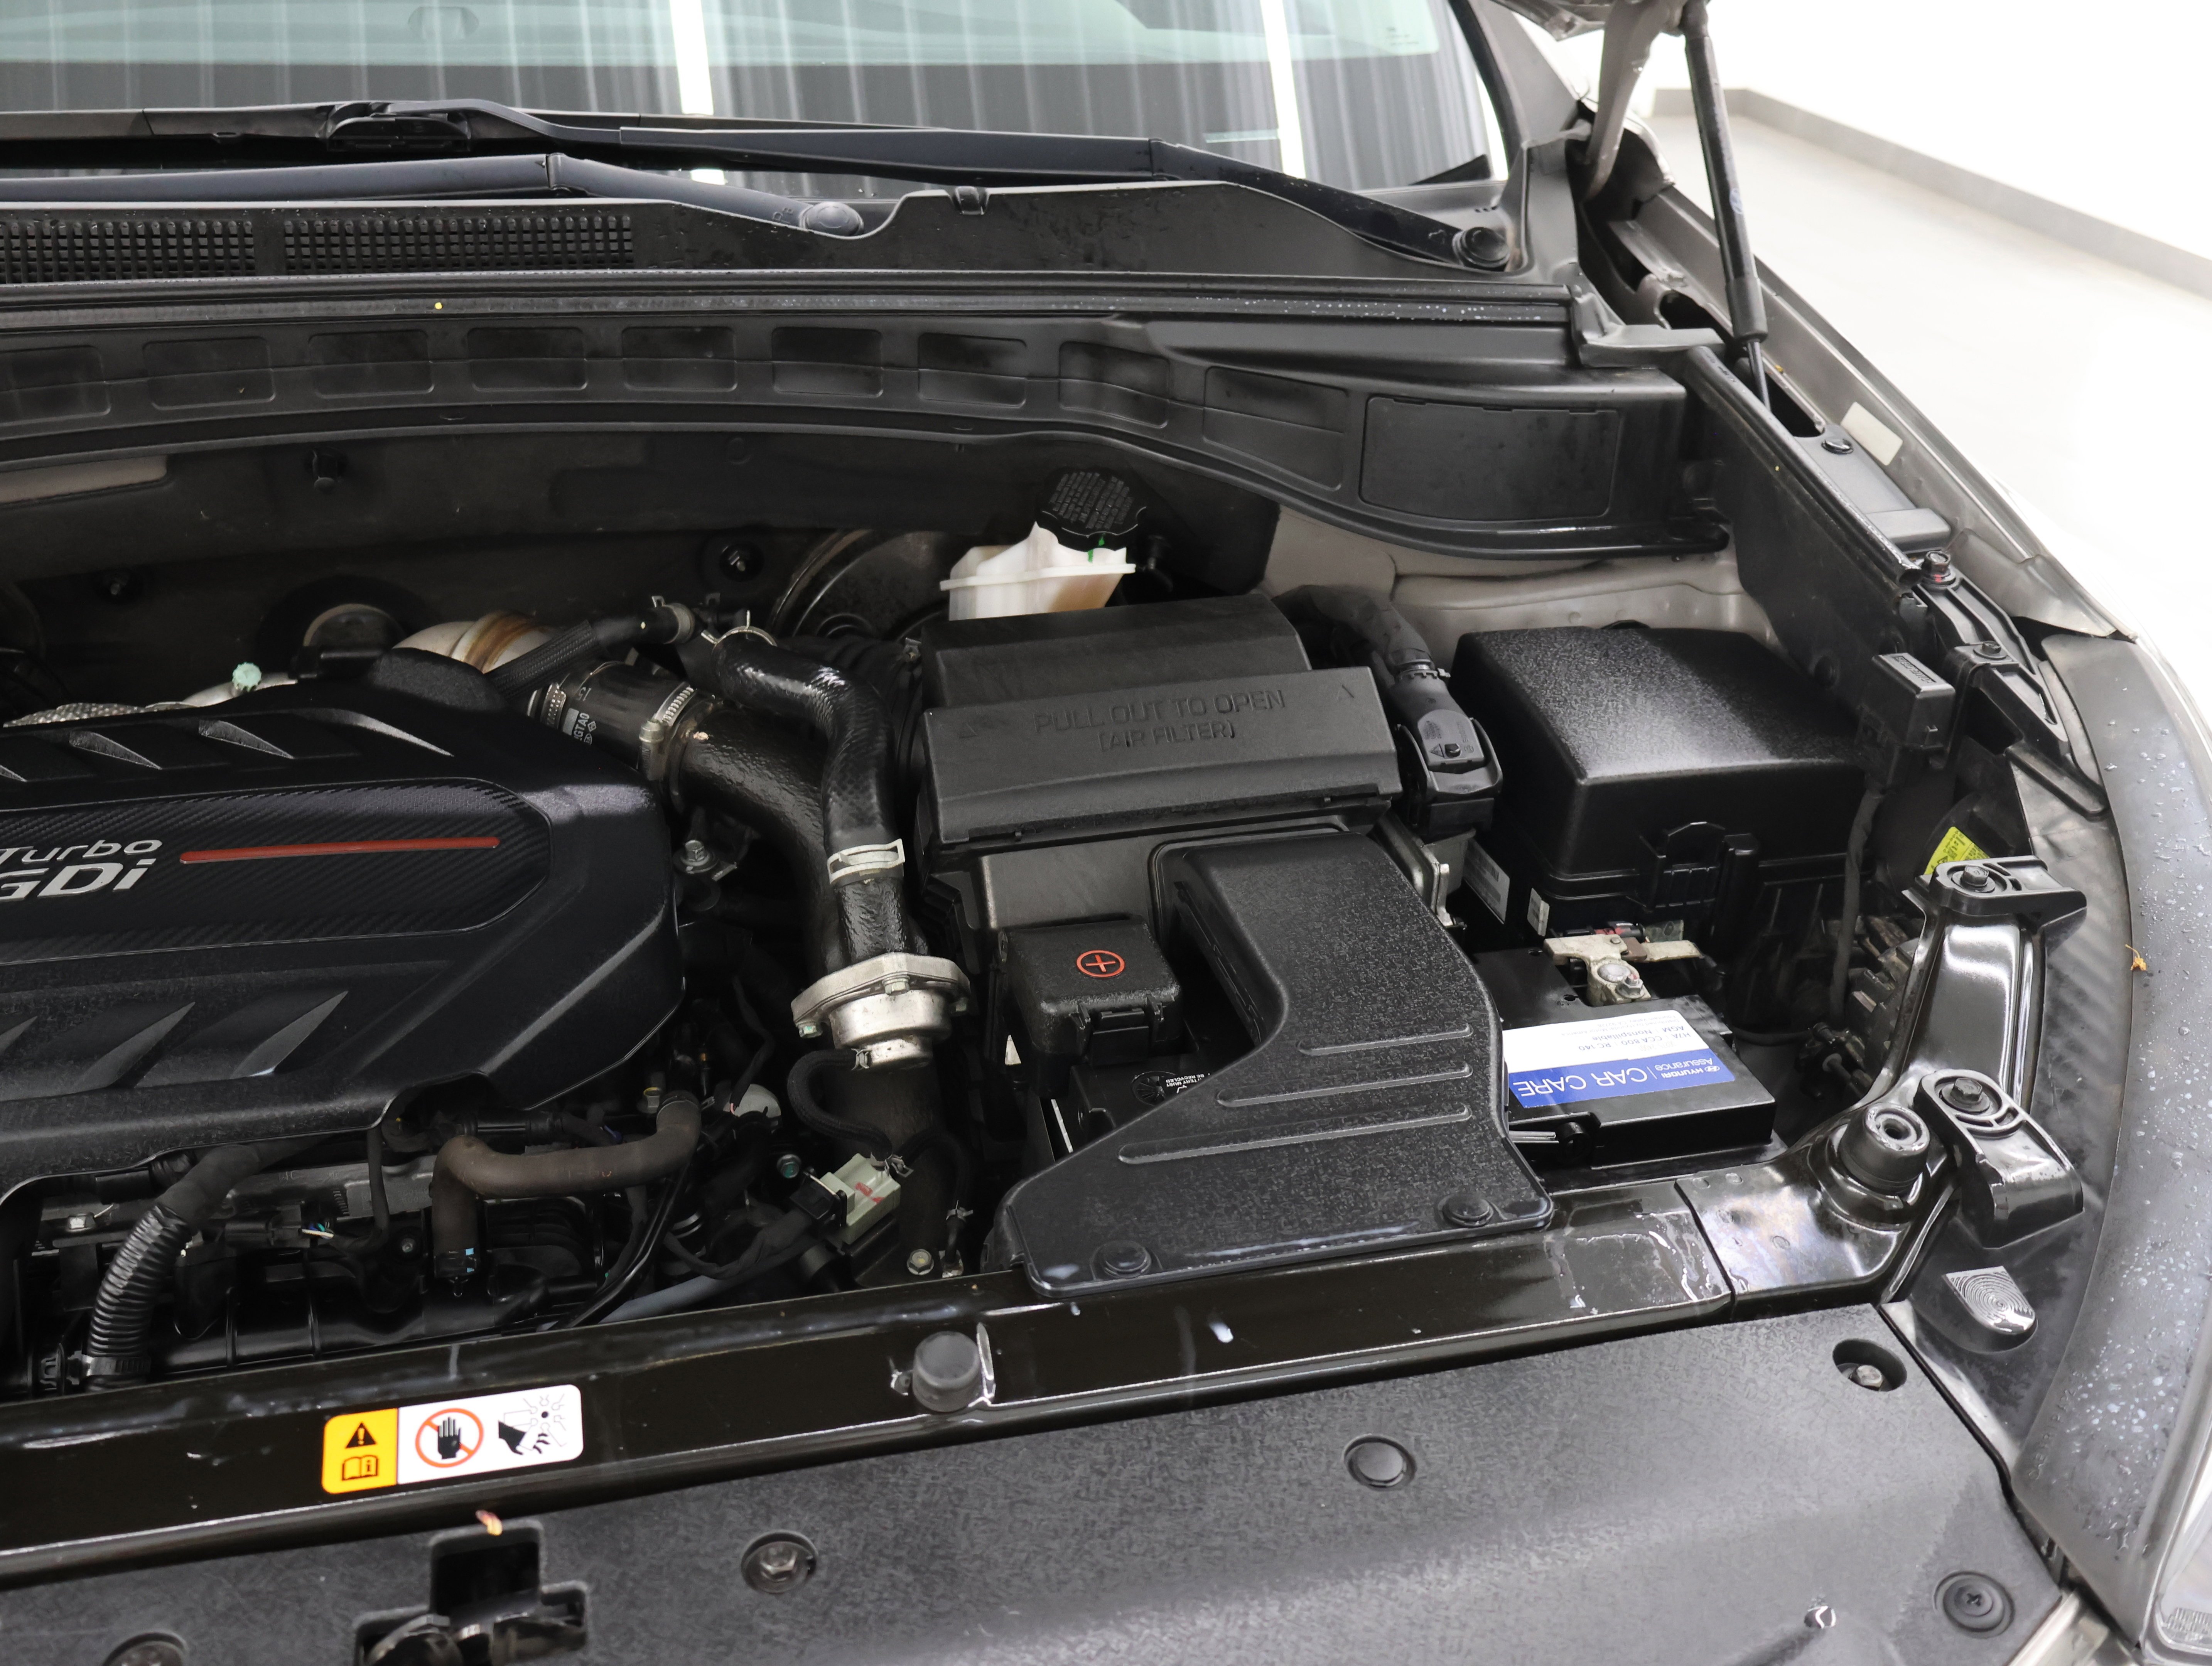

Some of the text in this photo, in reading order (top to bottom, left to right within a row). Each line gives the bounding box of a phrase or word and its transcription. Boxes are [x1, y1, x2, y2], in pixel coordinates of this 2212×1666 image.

[1033, 689, 1285, 733] PULL OUT TO OPEN
[1592, 1029, 1655, 1041] Nonspillable
[1654, 1058, 1713, 1071] Assurance
[1166, 1075, 1196, 1083] RECYCLED
[1661, 1068, 1704, 1079] HYUNDAI
[1513, 1067, 1648, 1097] CAR CARE
